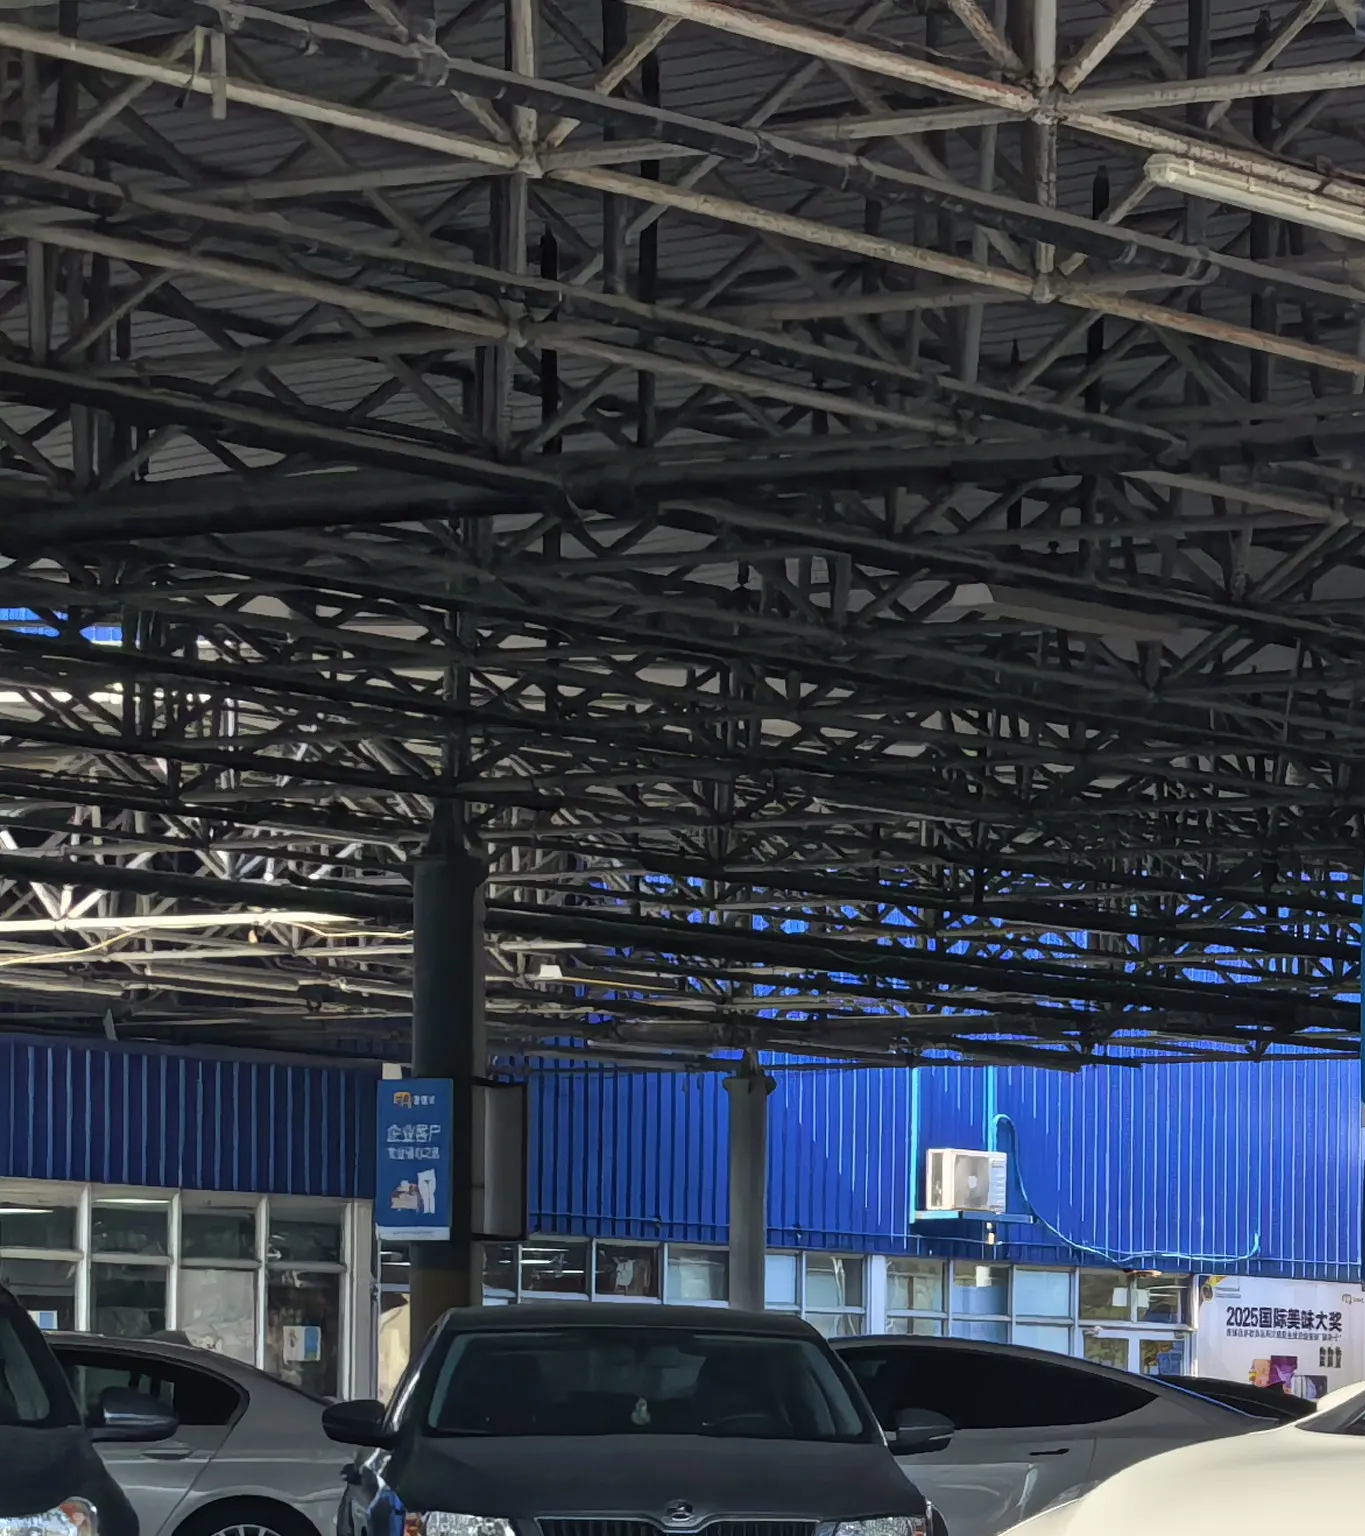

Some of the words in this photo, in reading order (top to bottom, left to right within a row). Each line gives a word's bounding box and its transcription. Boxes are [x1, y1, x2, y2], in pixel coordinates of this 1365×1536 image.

[1226, 1306, 1342, 1332] 2025国际美味大奖
